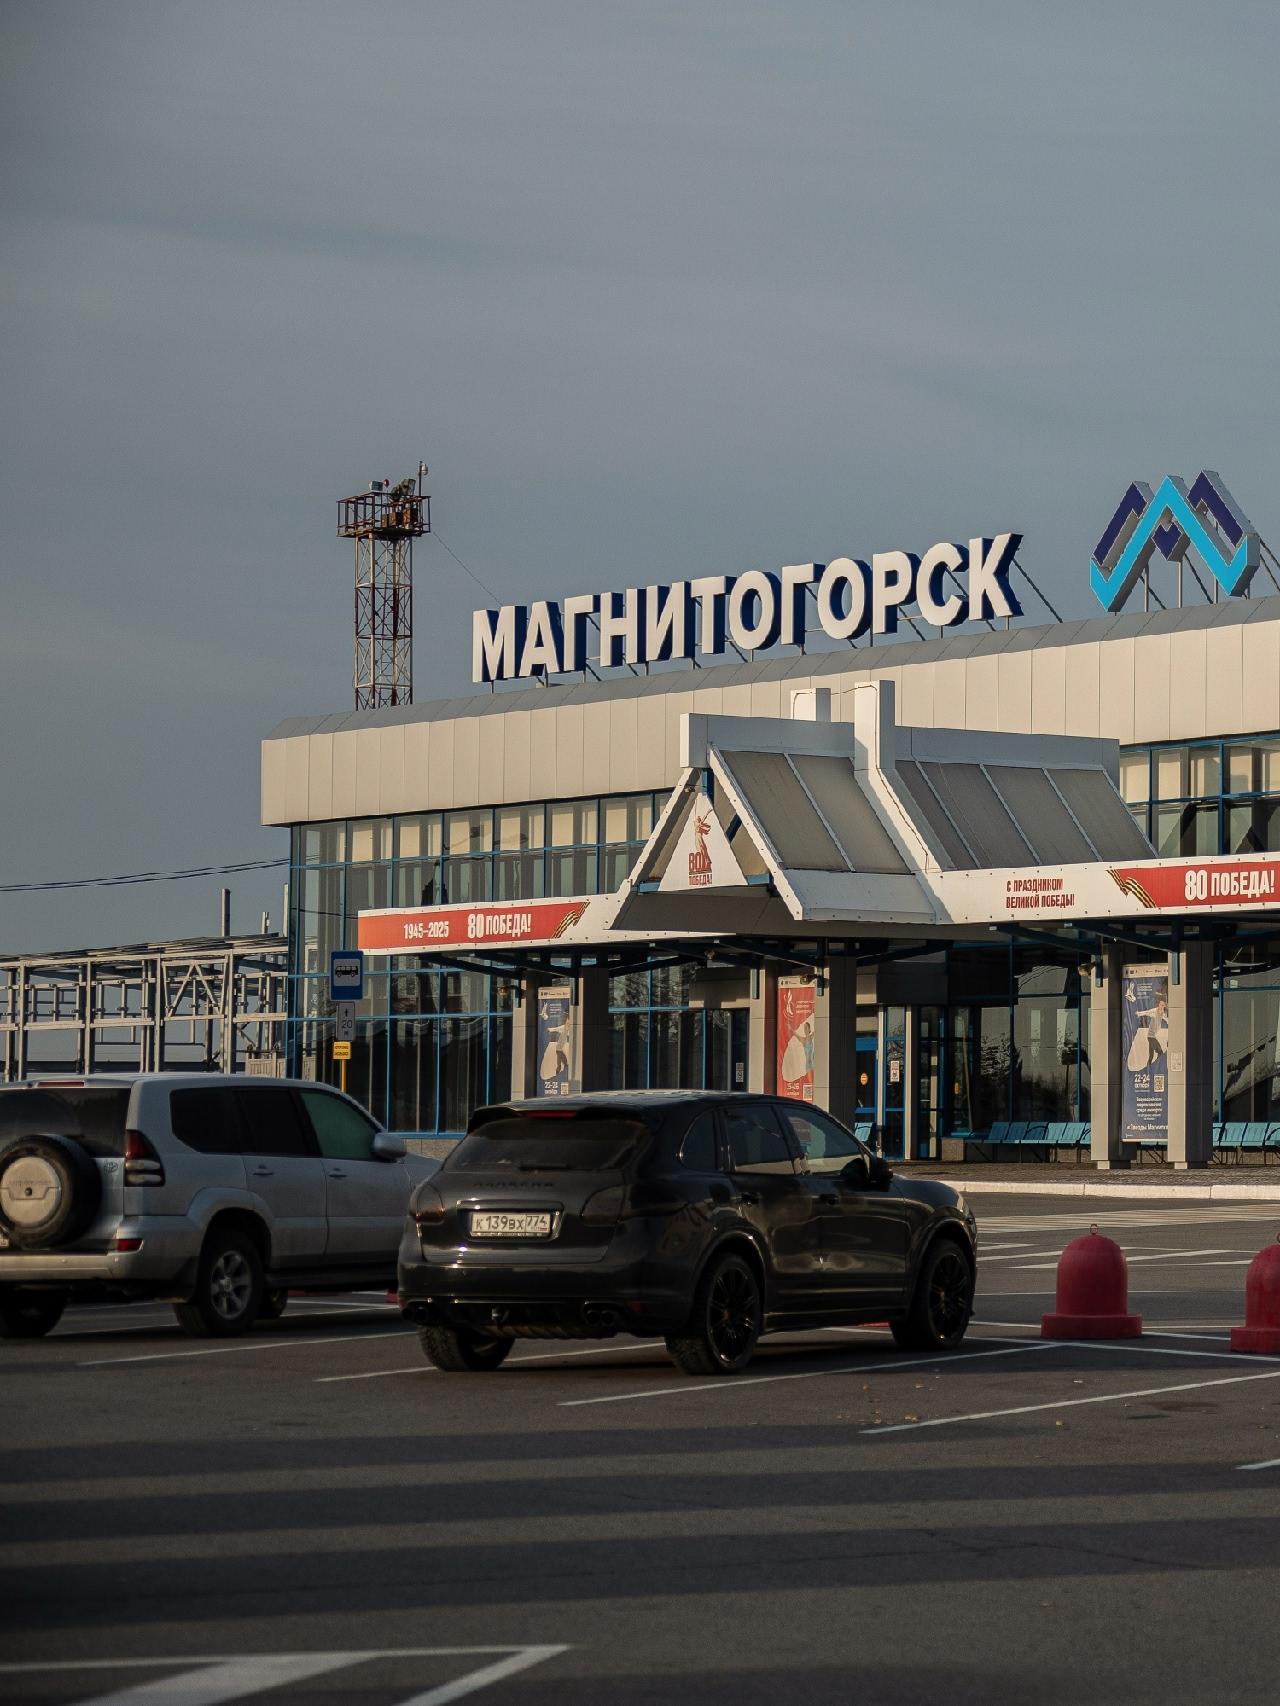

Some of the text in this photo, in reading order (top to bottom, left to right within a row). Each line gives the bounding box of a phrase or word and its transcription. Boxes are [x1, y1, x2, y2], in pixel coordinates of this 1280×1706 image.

[473, 532, 1024, 682] МАГНИТОГОРСК
[1006, 878, 1063, 893] С ПРАЗДНИКОМ
[1184, 870, 1207, 900] 80
[1211, 870, 1275, 898] ПОБЕДА!
[1006, 893, 1075, 908] ВЕЛИКОЙ ПОБЕДЫ!
[467, 913, 484, 938] 80
[485, 913, 532, 938] ПОБЕДА!
